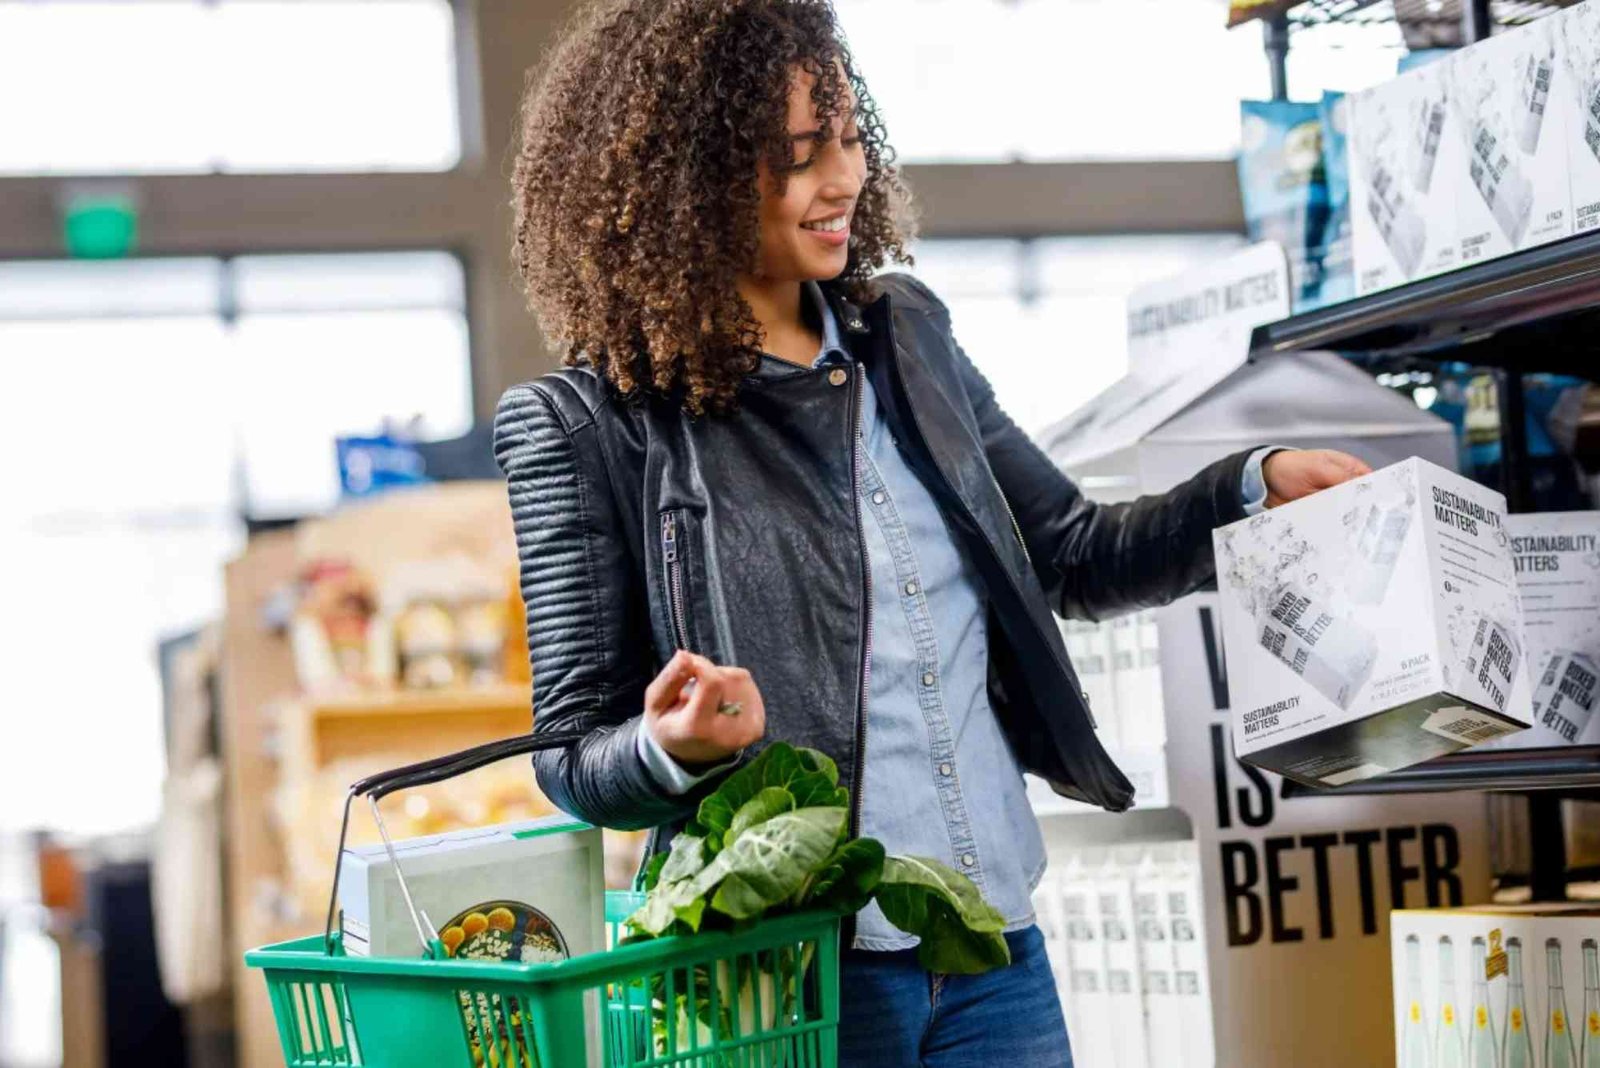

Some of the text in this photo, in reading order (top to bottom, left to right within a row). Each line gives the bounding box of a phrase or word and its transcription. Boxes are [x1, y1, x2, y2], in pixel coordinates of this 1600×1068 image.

[1432, 485, 1501, 530] SUSTAINABILITY
[1434, 504, 1478, 537] MATTERS
[1510, 535, 1596, 557] STAINABILITY
[1292, 623, 1307, 638] IS
[1408, 653, 1431, 669] PACK
[1486, 641, 1510, 680] WATER
[1490, 628, 1513, 665] BOXED
[1565, 660, 1596, 691] BOXED
[1550, 692, 1563, 711] IS
[1559, 676, 1590, 709] WATER
[1243, 695, 1300, 725] SUSTAINABILITY
[1244, 715, 1280, 736] MATTERS
[1219, 822, 1463, 947] BETTER
